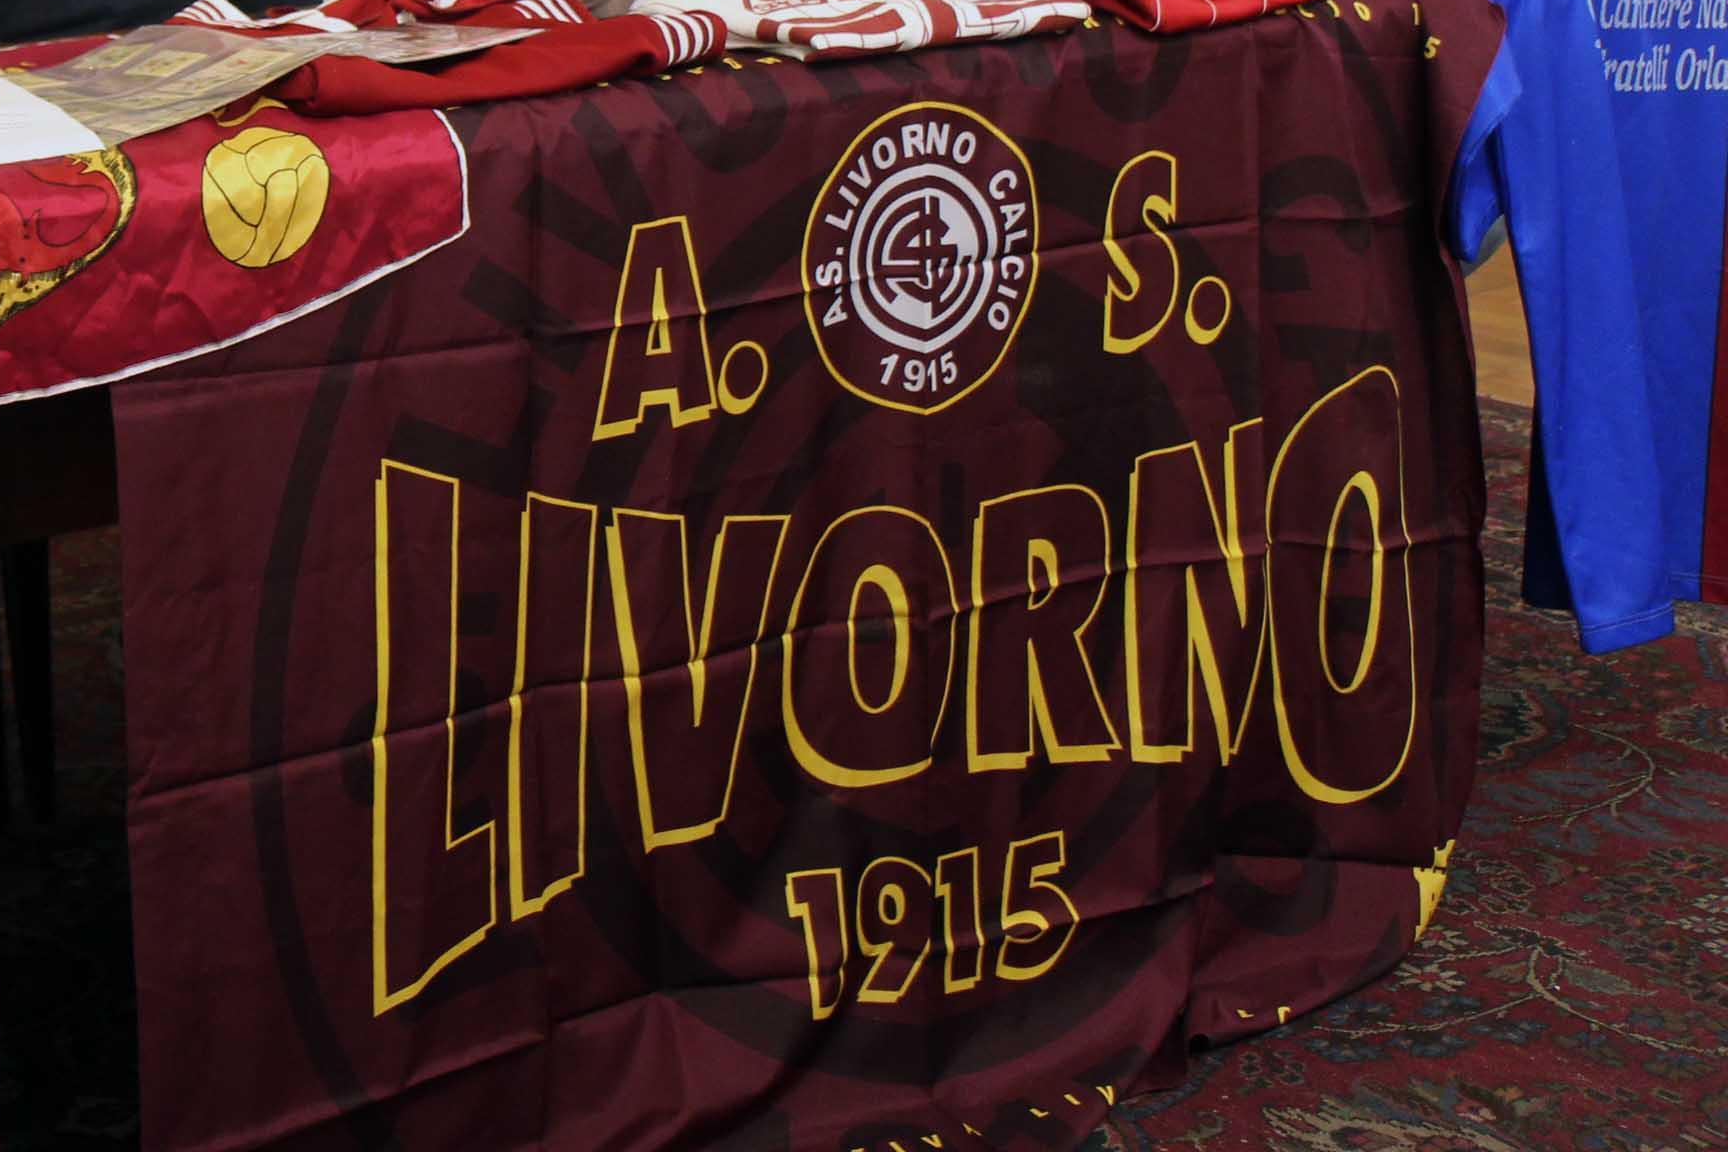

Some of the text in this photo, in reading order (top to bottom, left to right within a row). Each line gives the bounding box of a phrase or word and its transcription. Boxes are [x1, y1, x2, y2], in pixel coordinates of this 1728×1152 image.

[1675, 44, 1728, 91] Orla
[591, 150, 1233, 441] A. S.
[815, 121, 1029, 331] A.S. LIVORNO CALCIO
[879, 350, 959, 393] 1915
[371, 364, 1417, 1017] LIVORNO
[785, 830, 1081, 1020] 1915
